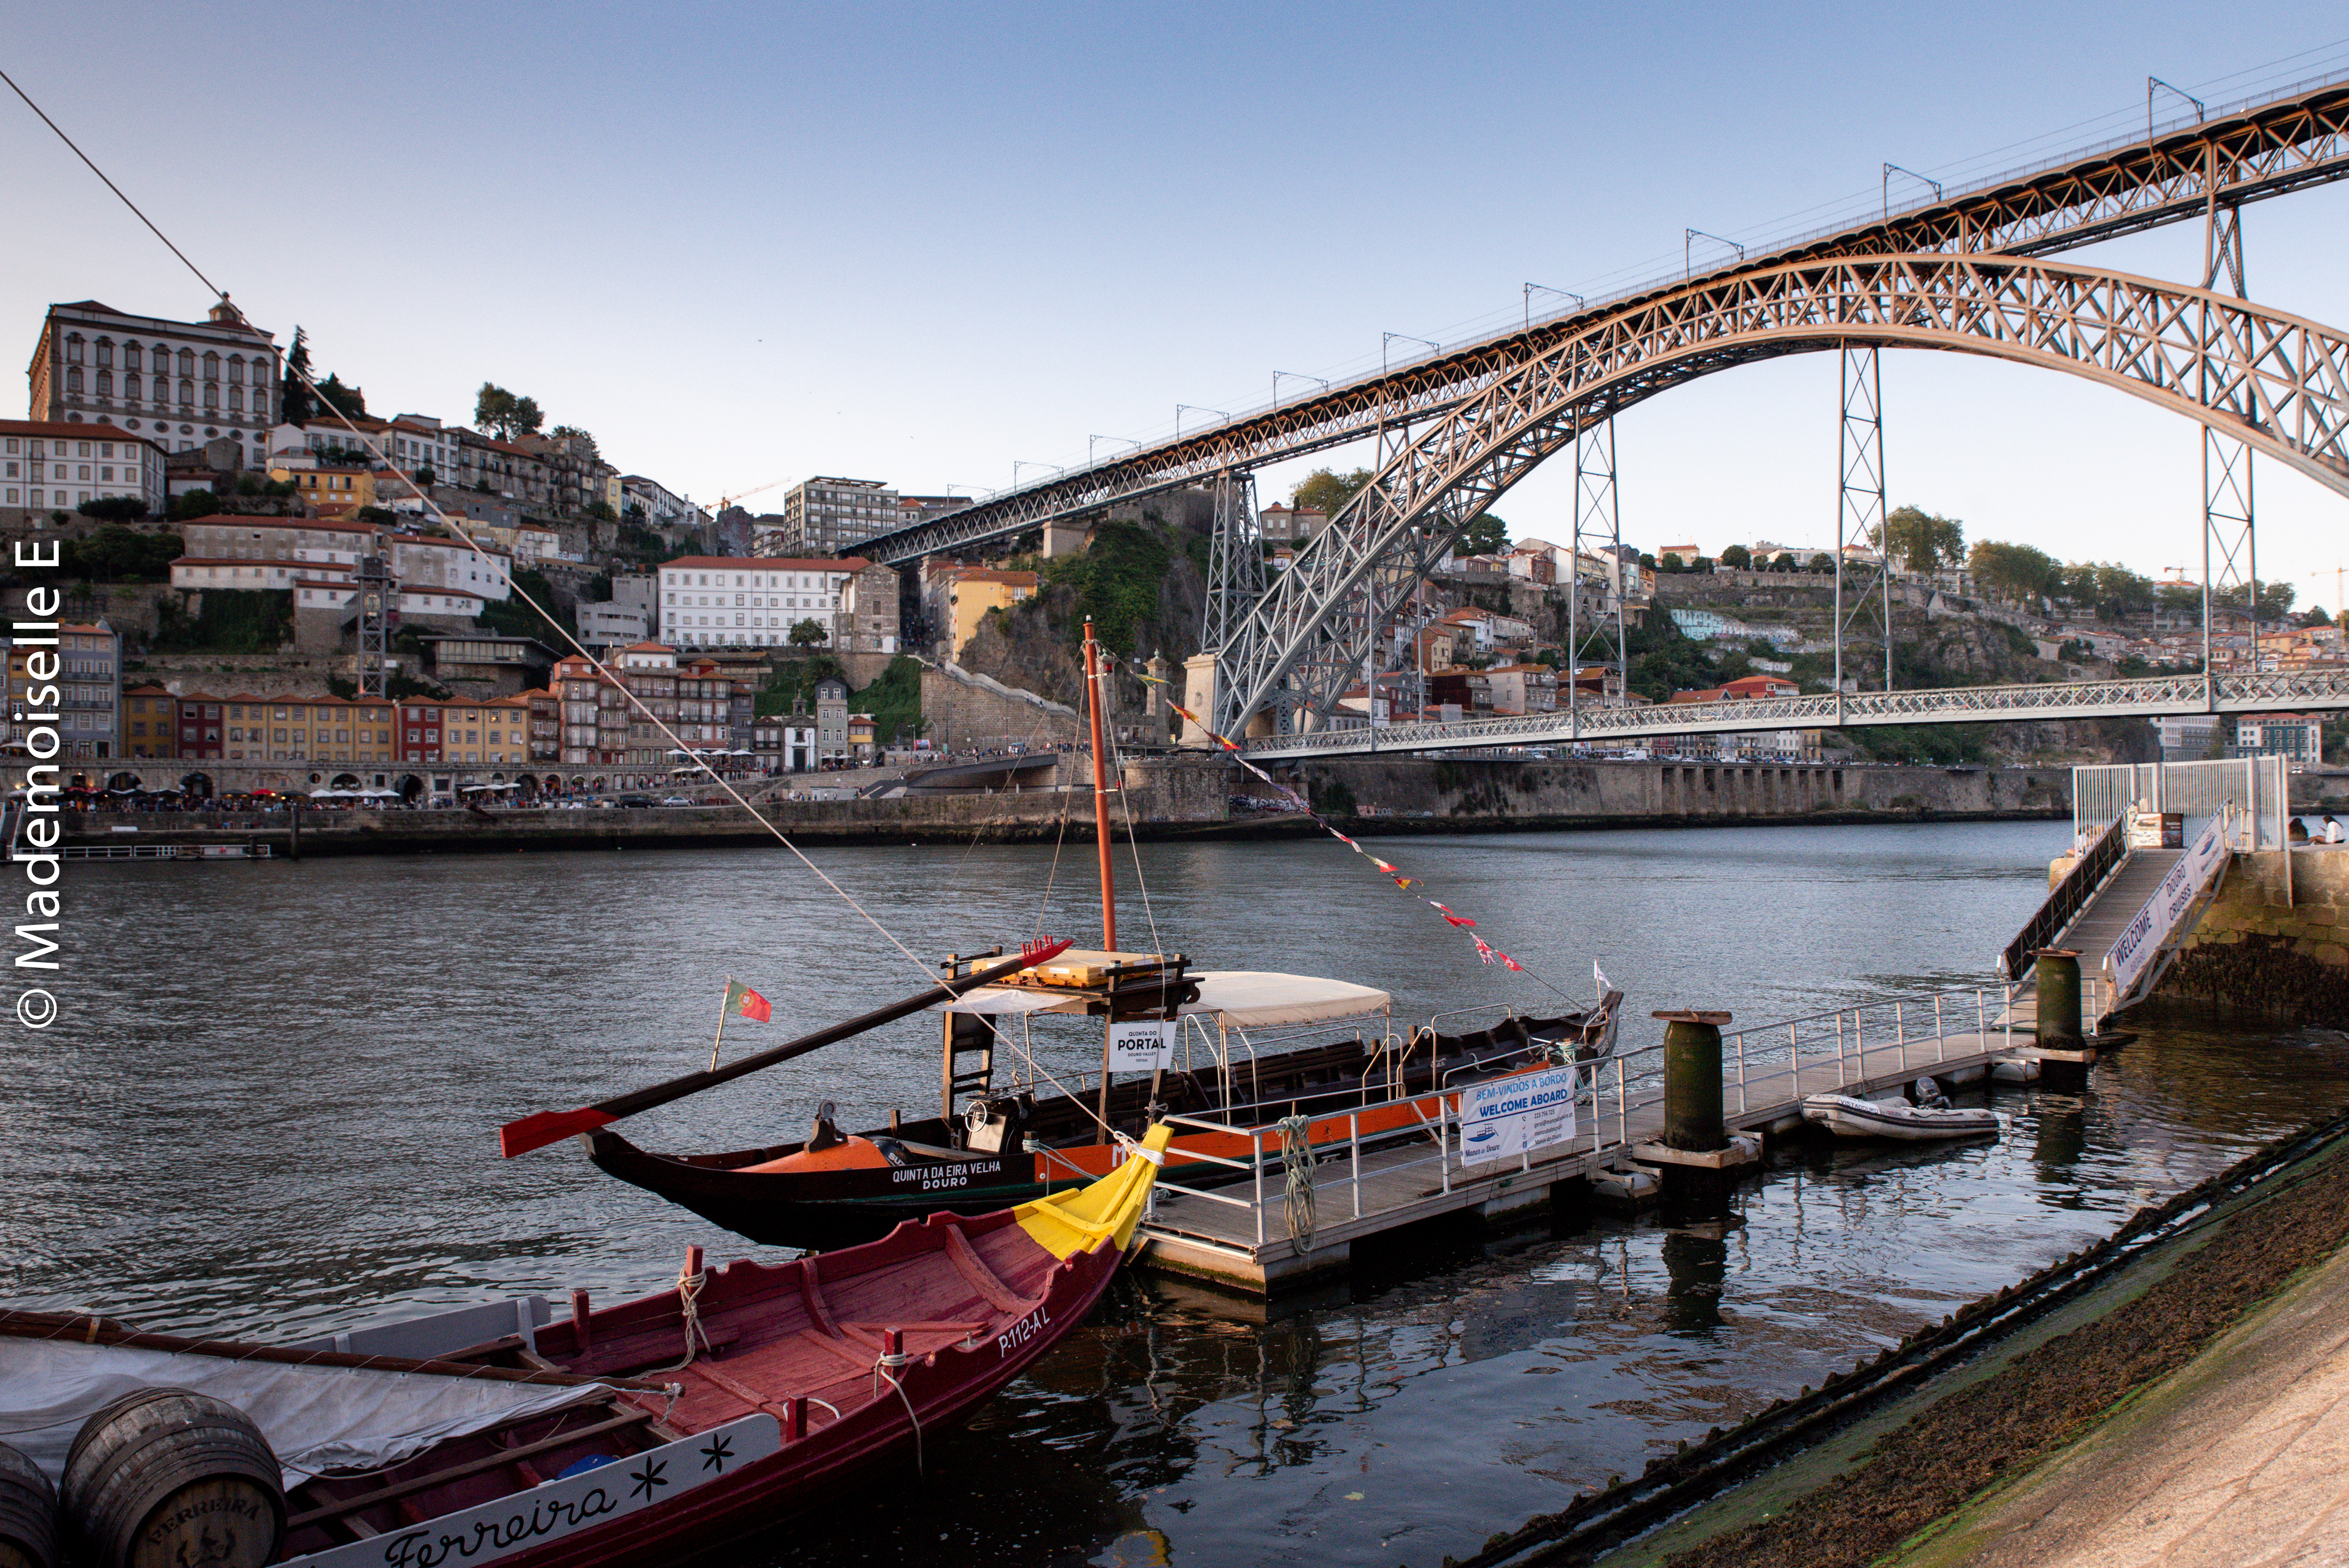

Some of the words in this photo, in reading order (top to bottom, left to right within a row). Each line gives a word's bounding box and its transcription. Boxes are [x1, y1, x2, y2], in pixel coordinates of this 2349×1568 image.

[2166, 864, 2185, 898] DOURO
[2168, 883, 2192, 921] CRUISES
[2114, 910, 2152, 967] WELCOME
[1118, 1038, 1166, 1051] PORTAL
[1476, 1080, 1529, 1101] BEM-VINDOS
[1532, 1079, 1538, 1089] A
[1539, 1073, 1567, 1087] BORDO
[1480, 1097, 1528, 1117] WELCOME
[1530, 1089, 1567, 1106] ABOARD
[1465, 1149, 1480, 1157] Manos
[1486, 1144, 1500, 1152] Douro
[893, 1168, 928, 1182] QUINTA
[931, 1166, 943, 1178] DA
[946, 1164, 967, 1177] EIRA
[970, 1161, 1001, 1174] VELHA
[923, 1177, 967, 1189] DOURO
[147, 1497, 260, 1545] FERREIRA
[385, 1487, 617, 1568] Ferreira
